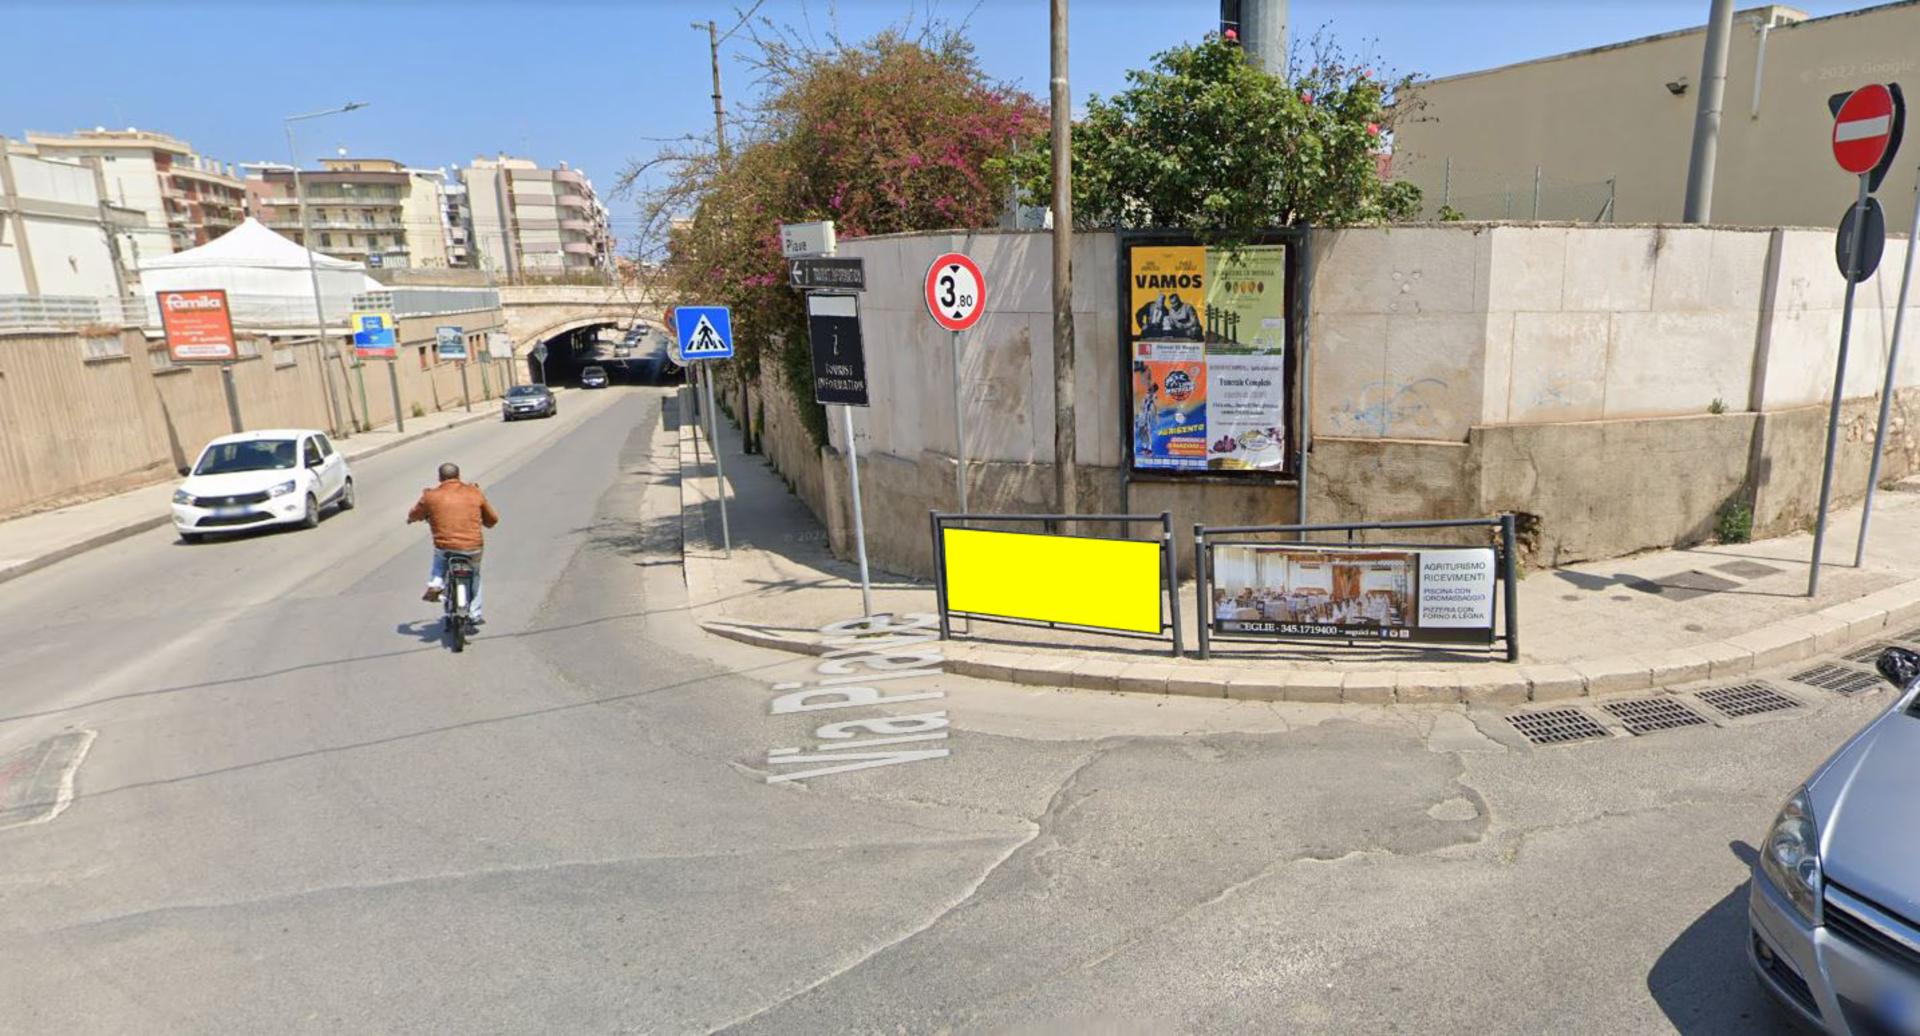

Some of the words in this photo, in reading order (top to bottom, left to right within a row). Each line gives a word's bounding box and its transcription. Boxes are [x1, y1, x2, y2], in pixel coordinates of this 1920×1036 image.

[786, 239, 807, 252] Piave
[1135, 274, 1203, 289] VAMOS
[166, 294, 221, 311] famila
[825, 364, 853, 377] TOURIST
[817, 378, 864, 391] INFORMATION
[1424, 562, 1486, 571] AGRITURISMO
[1424, 573, 1485, 581] RICEVIMENTI
[1280, 624, 1338, 636] 345.1719400
